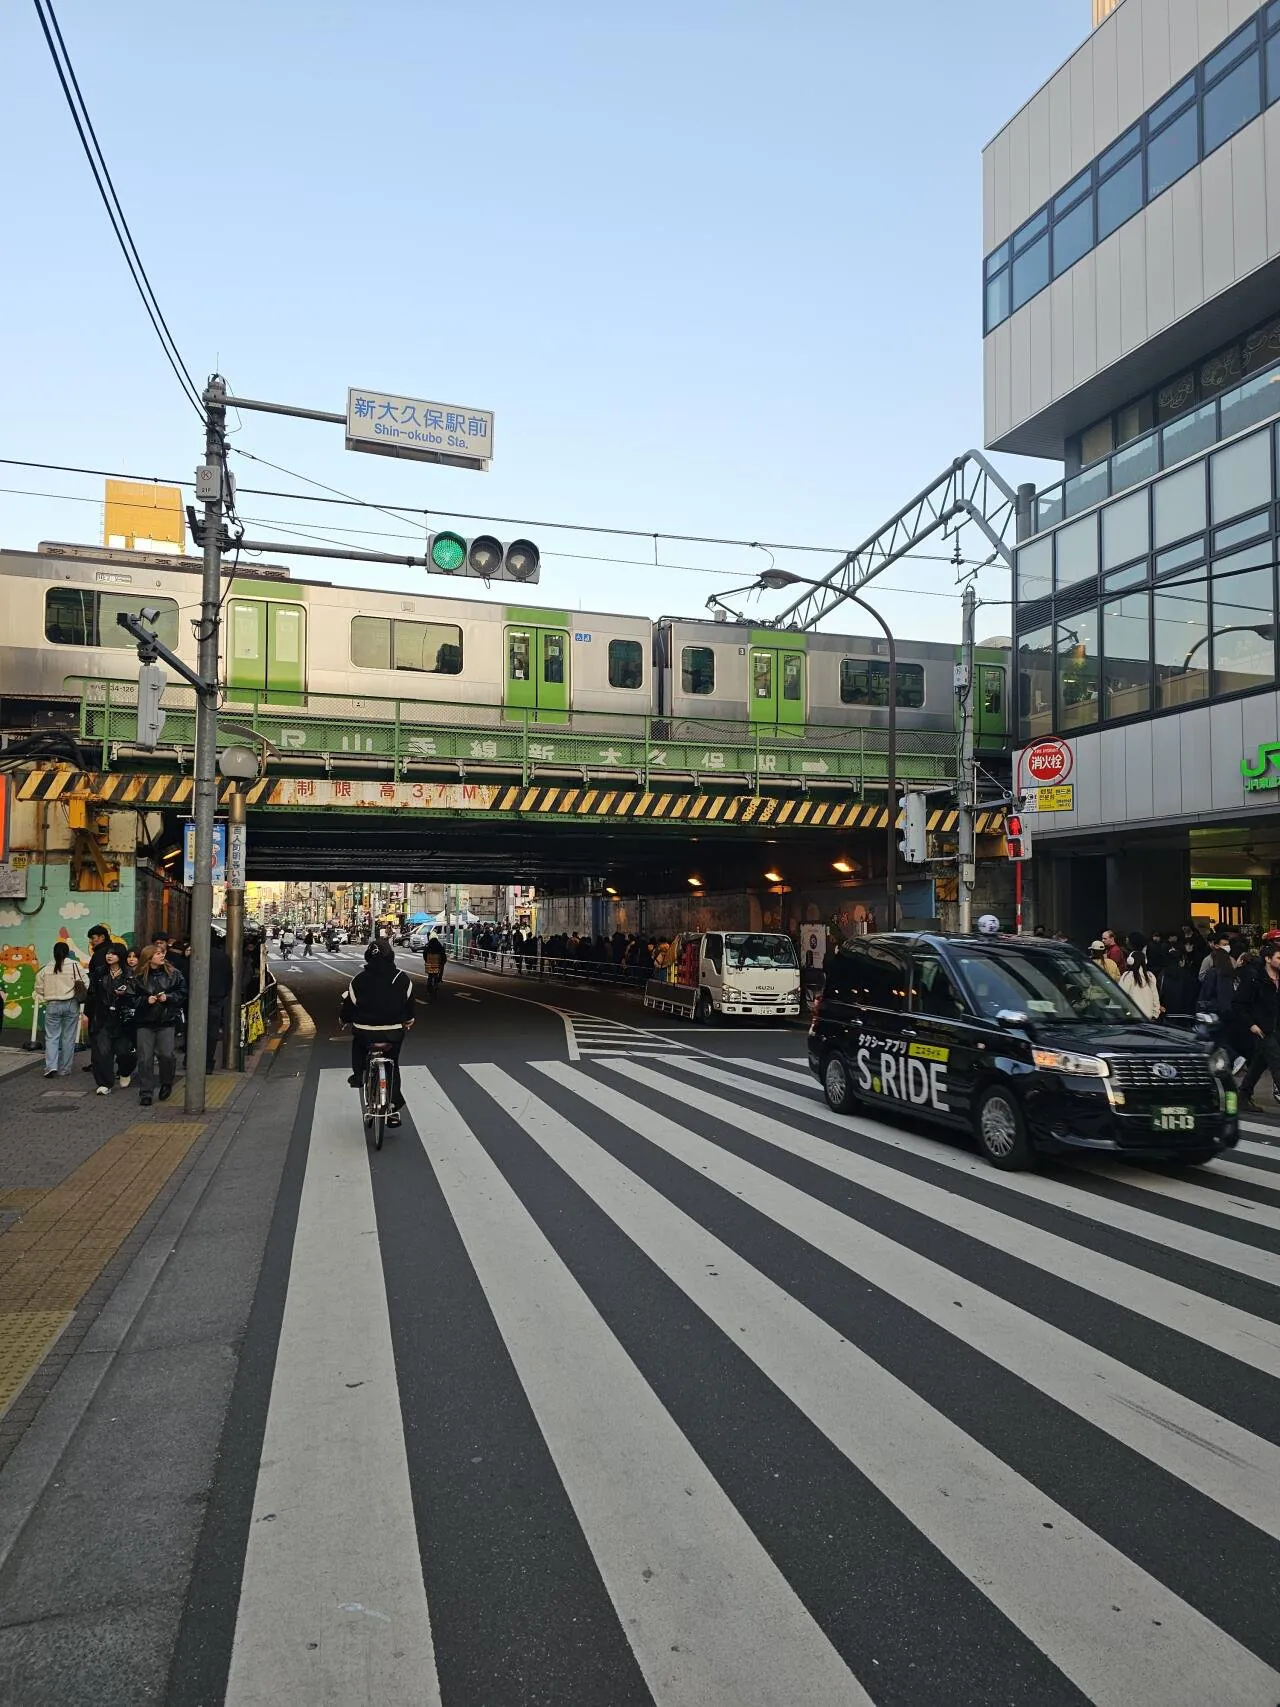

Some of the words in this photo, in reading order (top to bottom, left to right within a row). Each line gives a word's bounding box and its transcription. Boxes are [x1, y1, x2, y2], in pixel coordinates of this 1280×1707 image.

[354, 396, 488, 437] 新大久保駅前
[374, 422, 442, 444] Shin-okubo
[447, 435, 469, 449] Sta.
[1032, 755, 1062, 770] 消火栓
[859, 1033, 908, 1054] タクシーアプリ
